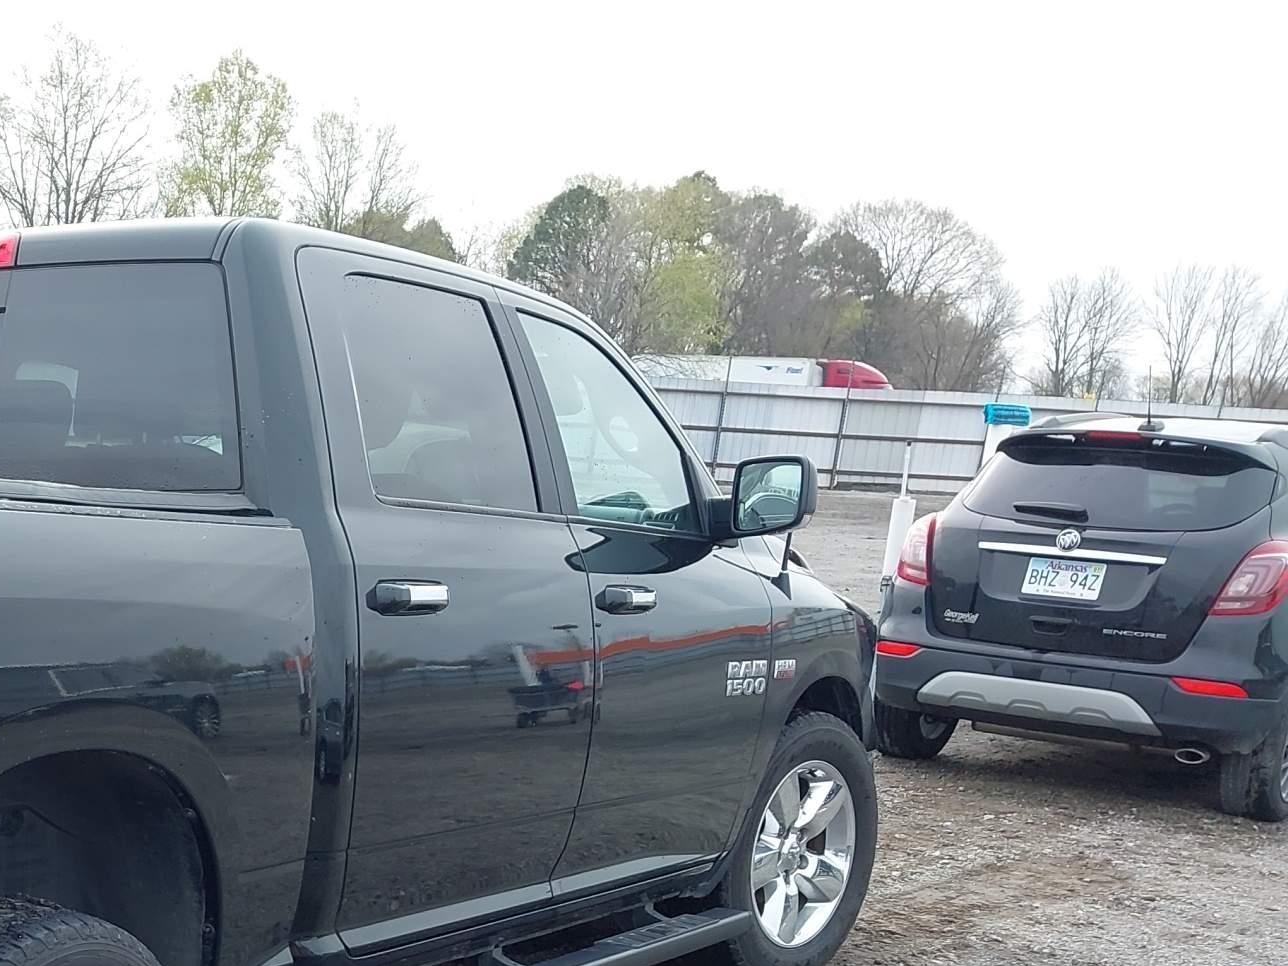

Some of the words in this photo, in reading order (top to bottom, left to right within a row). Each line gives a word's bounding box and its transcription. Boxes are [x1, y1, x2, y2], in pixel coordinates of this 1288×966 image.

[1046, 560, 1089, 573] Arkansas
[1028, 568, 1060, 588] BHZ
[1069, 572, 1101, 592] 94Z
[1102, 628, 1168, 640] ENCORE
[727, 660, 768, 678] RAM
[726, 677, 766, 697] 1500
